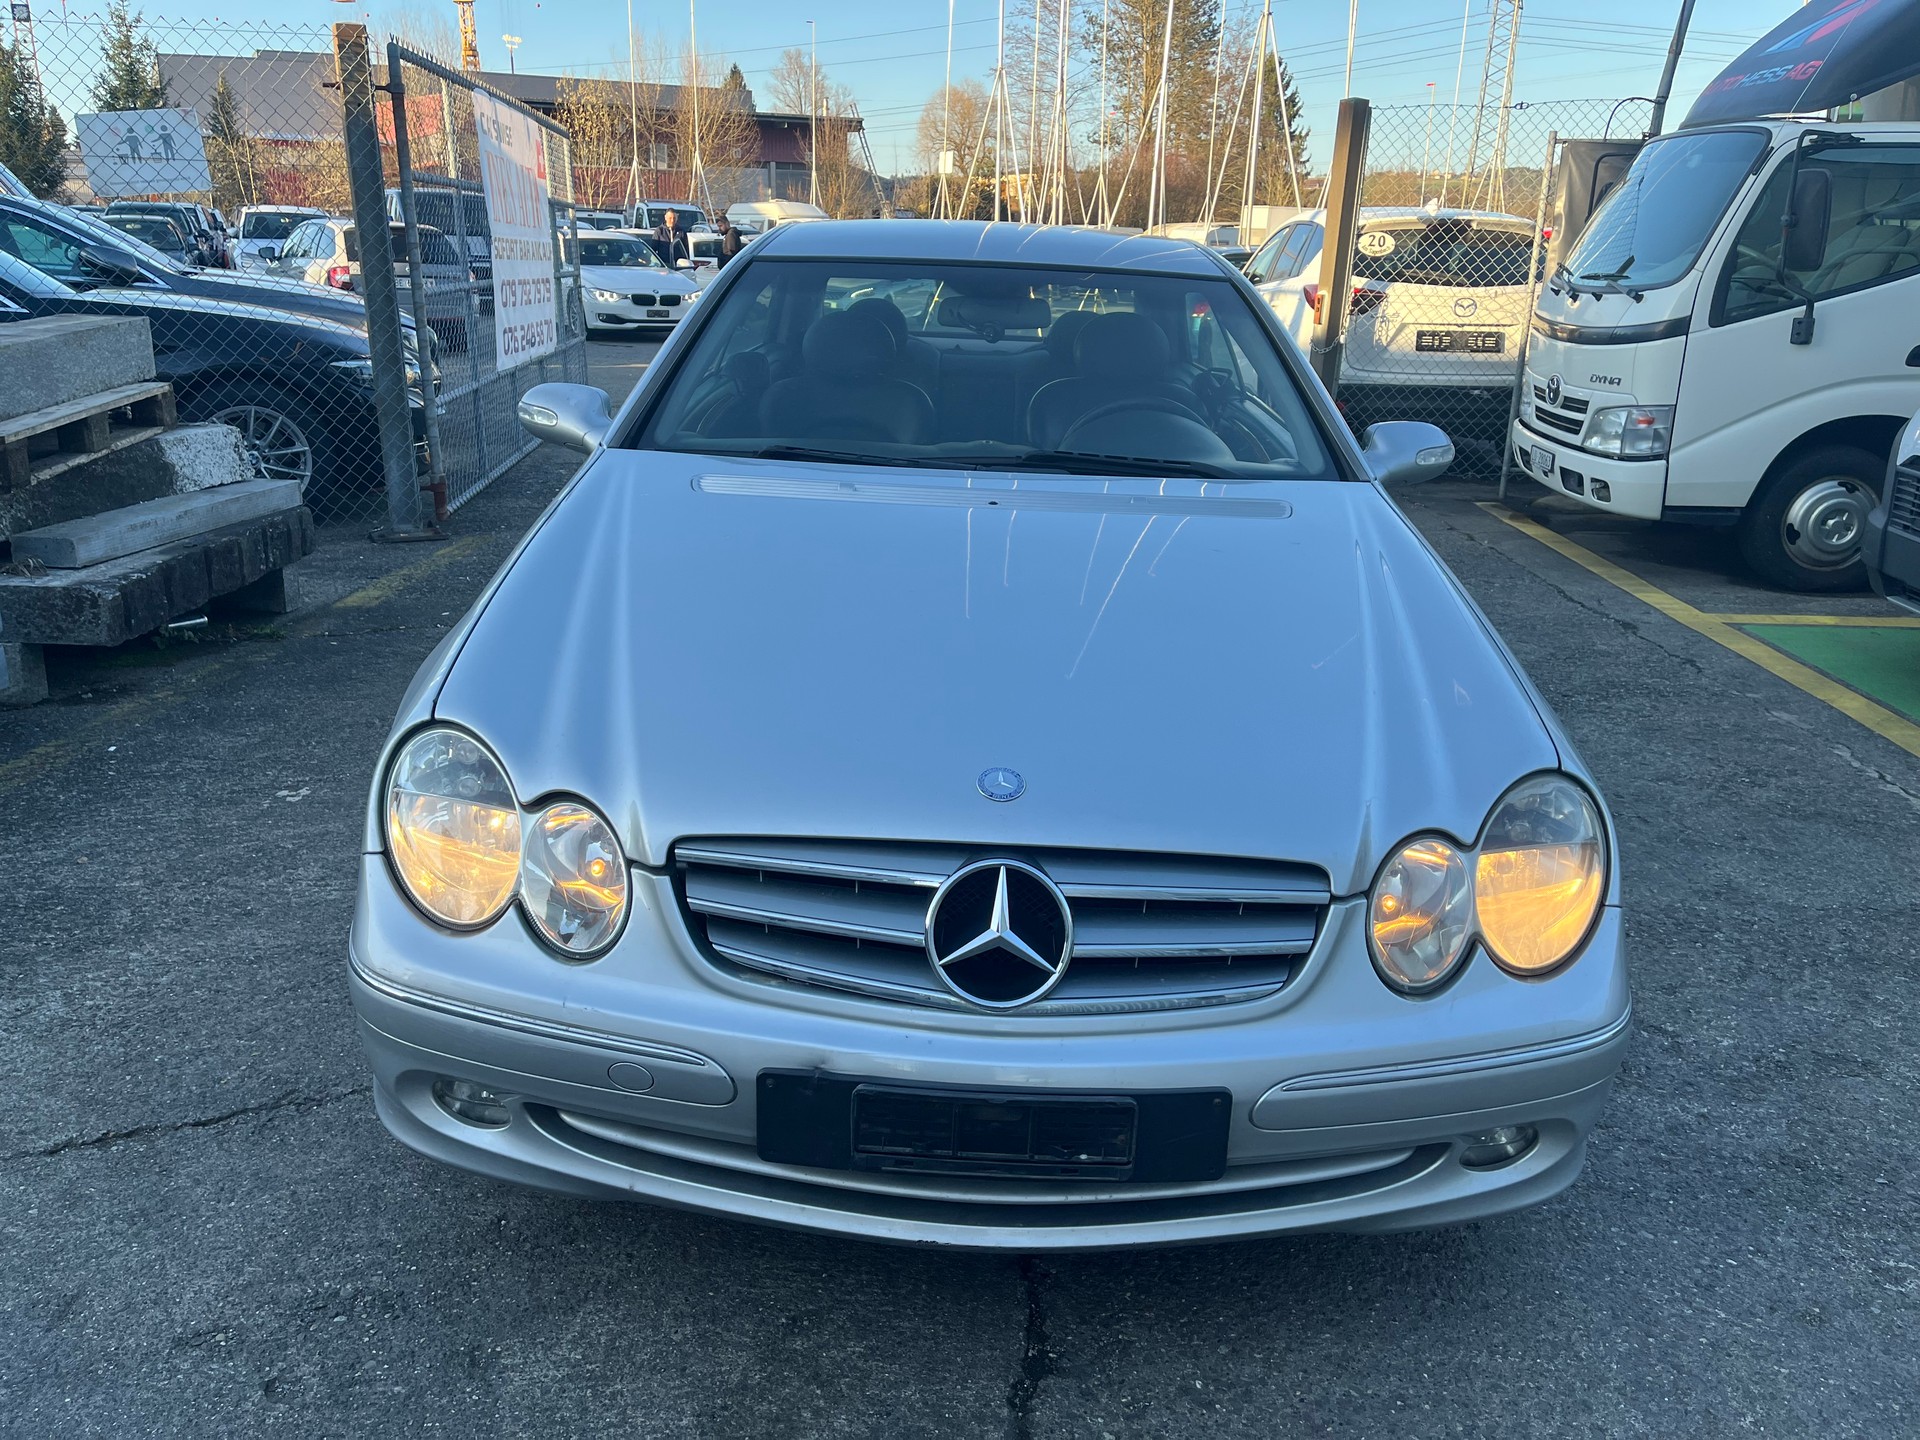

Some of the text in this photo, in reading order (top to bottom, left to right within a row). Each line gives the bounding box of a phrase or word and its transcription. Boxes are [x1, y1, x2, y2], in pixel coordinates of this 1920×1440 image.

[494, 237, 518, 260] SOFORT
[1368, 235, 1386, 247] 20
[501, 279, 517, 308] 079
[502, 325, 519, 356] 076
[1590, 373, 1622, 386] DYNA
